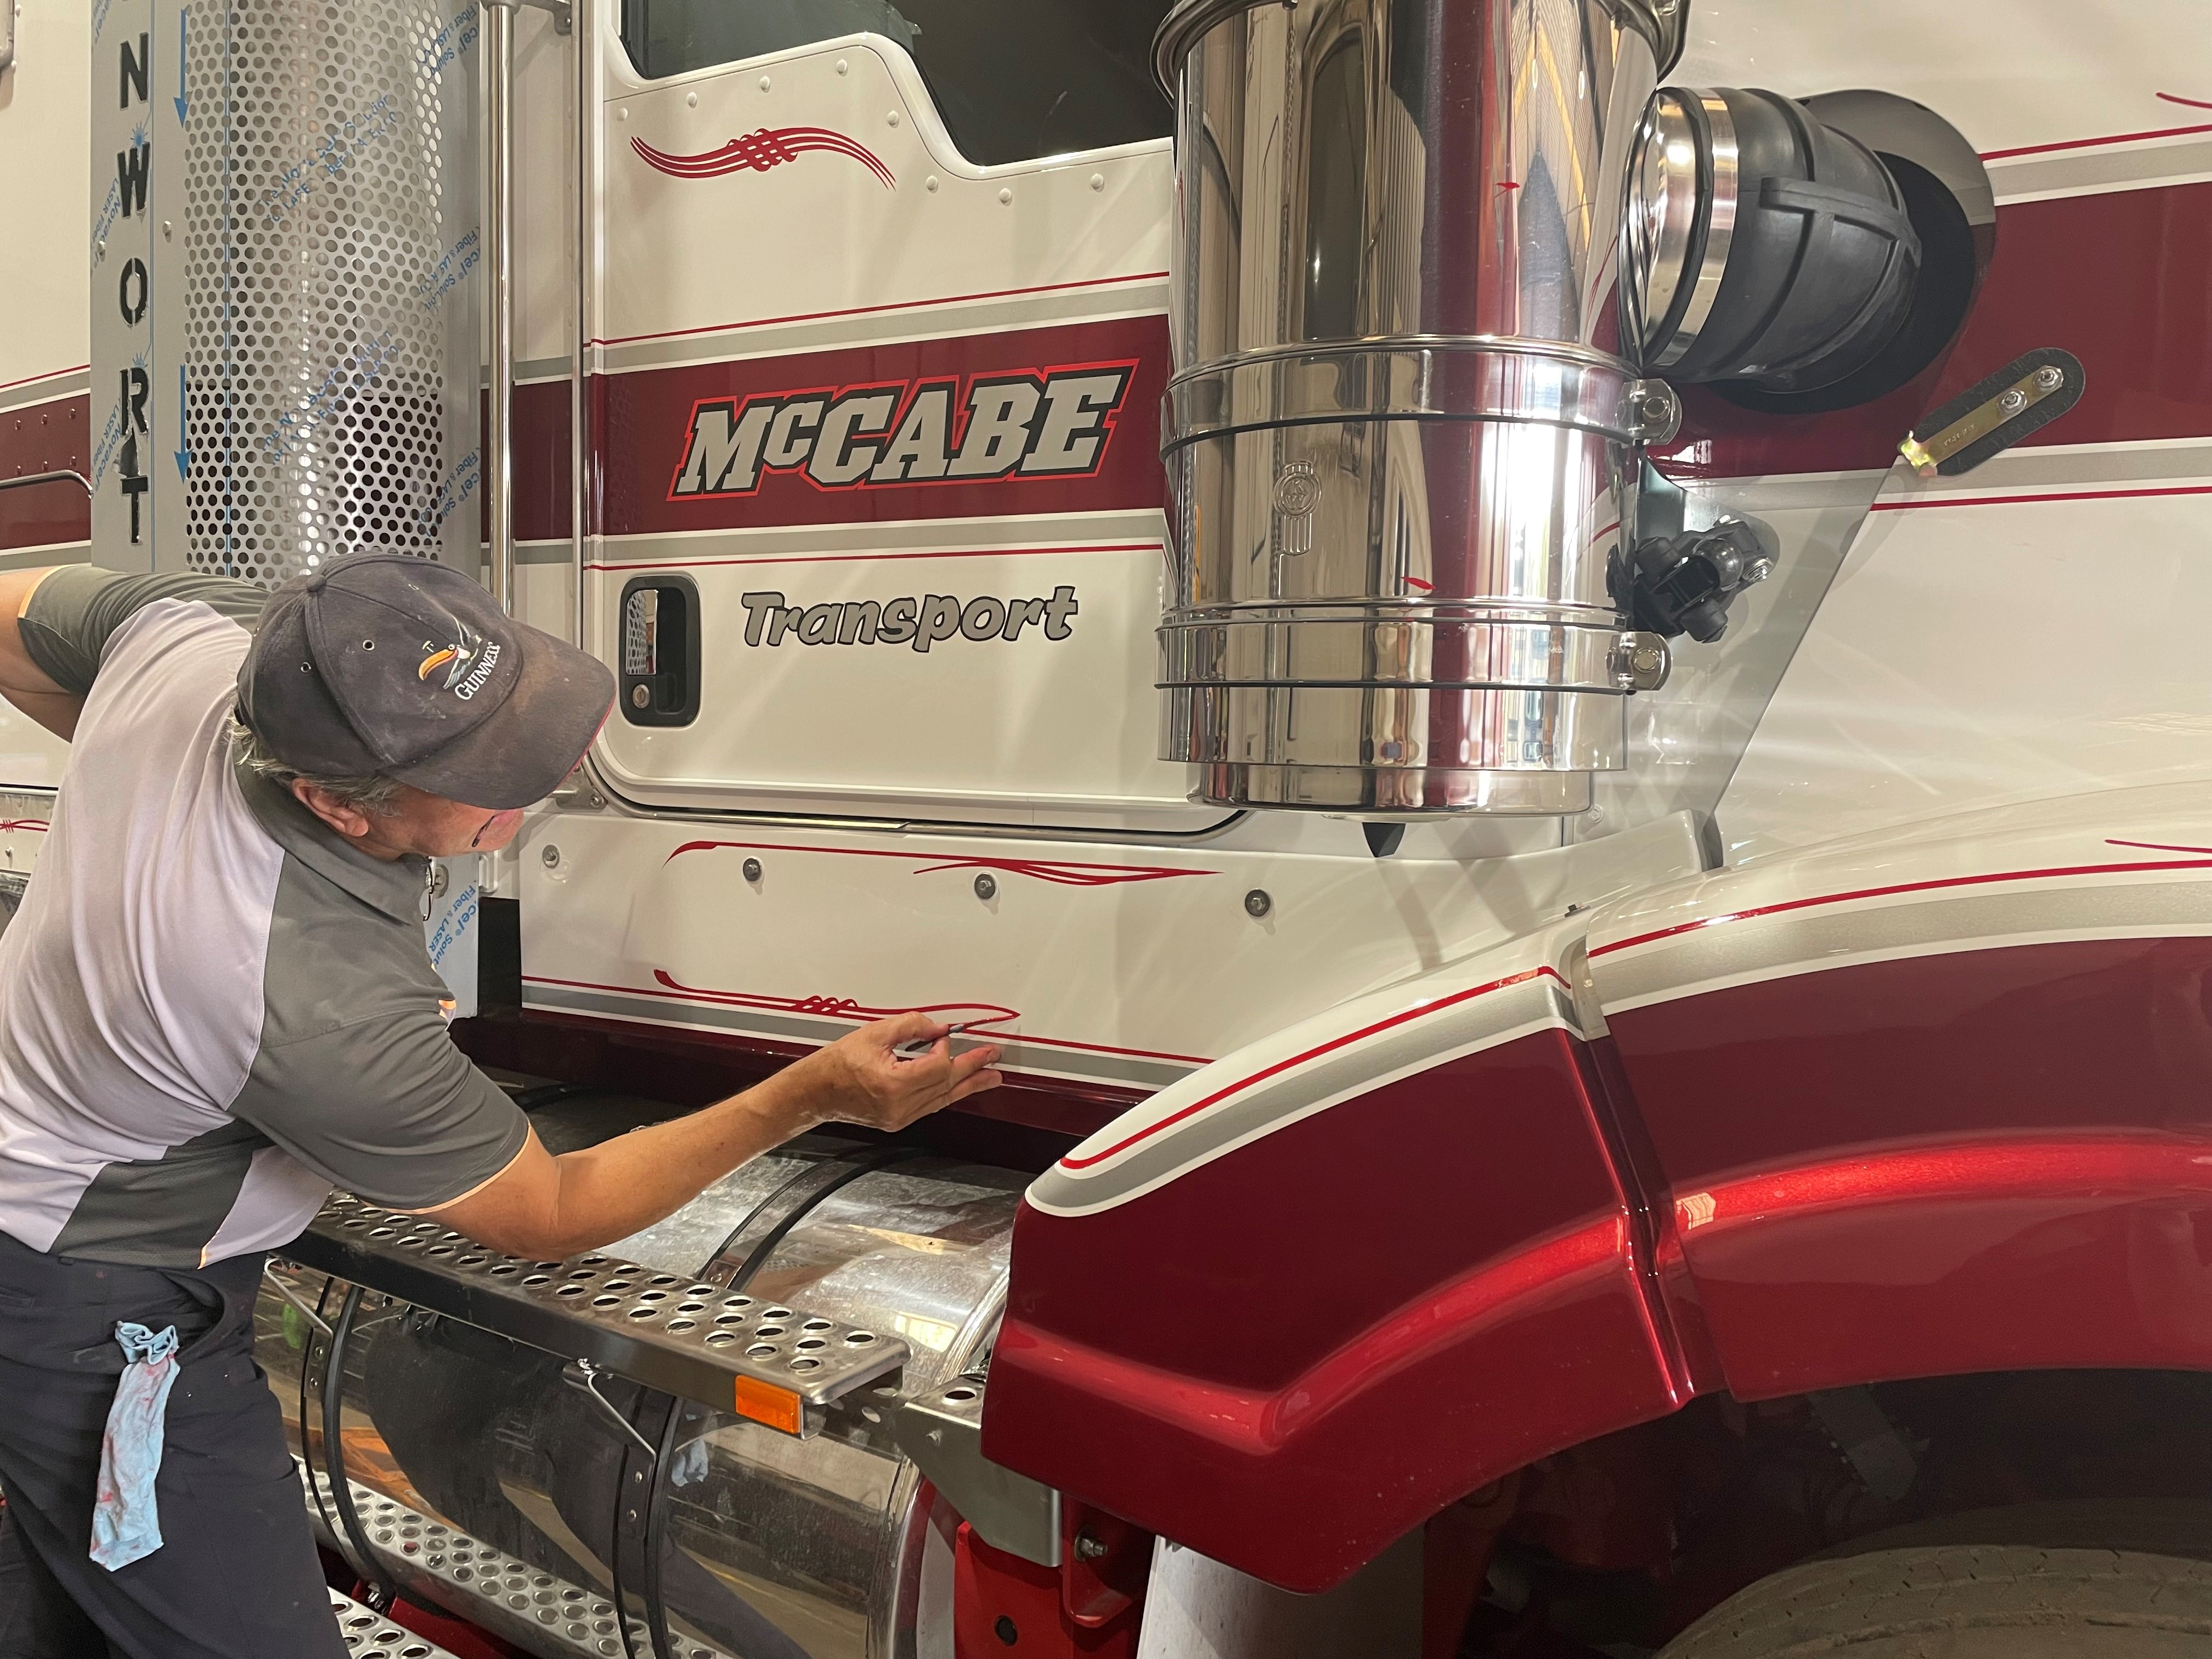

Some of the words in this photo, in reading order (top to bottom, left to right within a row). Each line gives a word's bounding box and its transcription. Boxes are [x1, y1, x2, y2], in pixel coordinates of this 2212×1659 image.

[103, 177, 119, 216] LASER
[455, 230, 477, 254] Fiber
[102, 403, 120, 440] LASER
[455, 452, 478, 476] Fiber
[741, 585, 1078, 653] Transport
[455, 641, 500, 701] GUINNESS
[453, 885, 476, 913] Fiber
[428, 918, 449, 952] LASER
[430, 934, 453, 966] Solut
